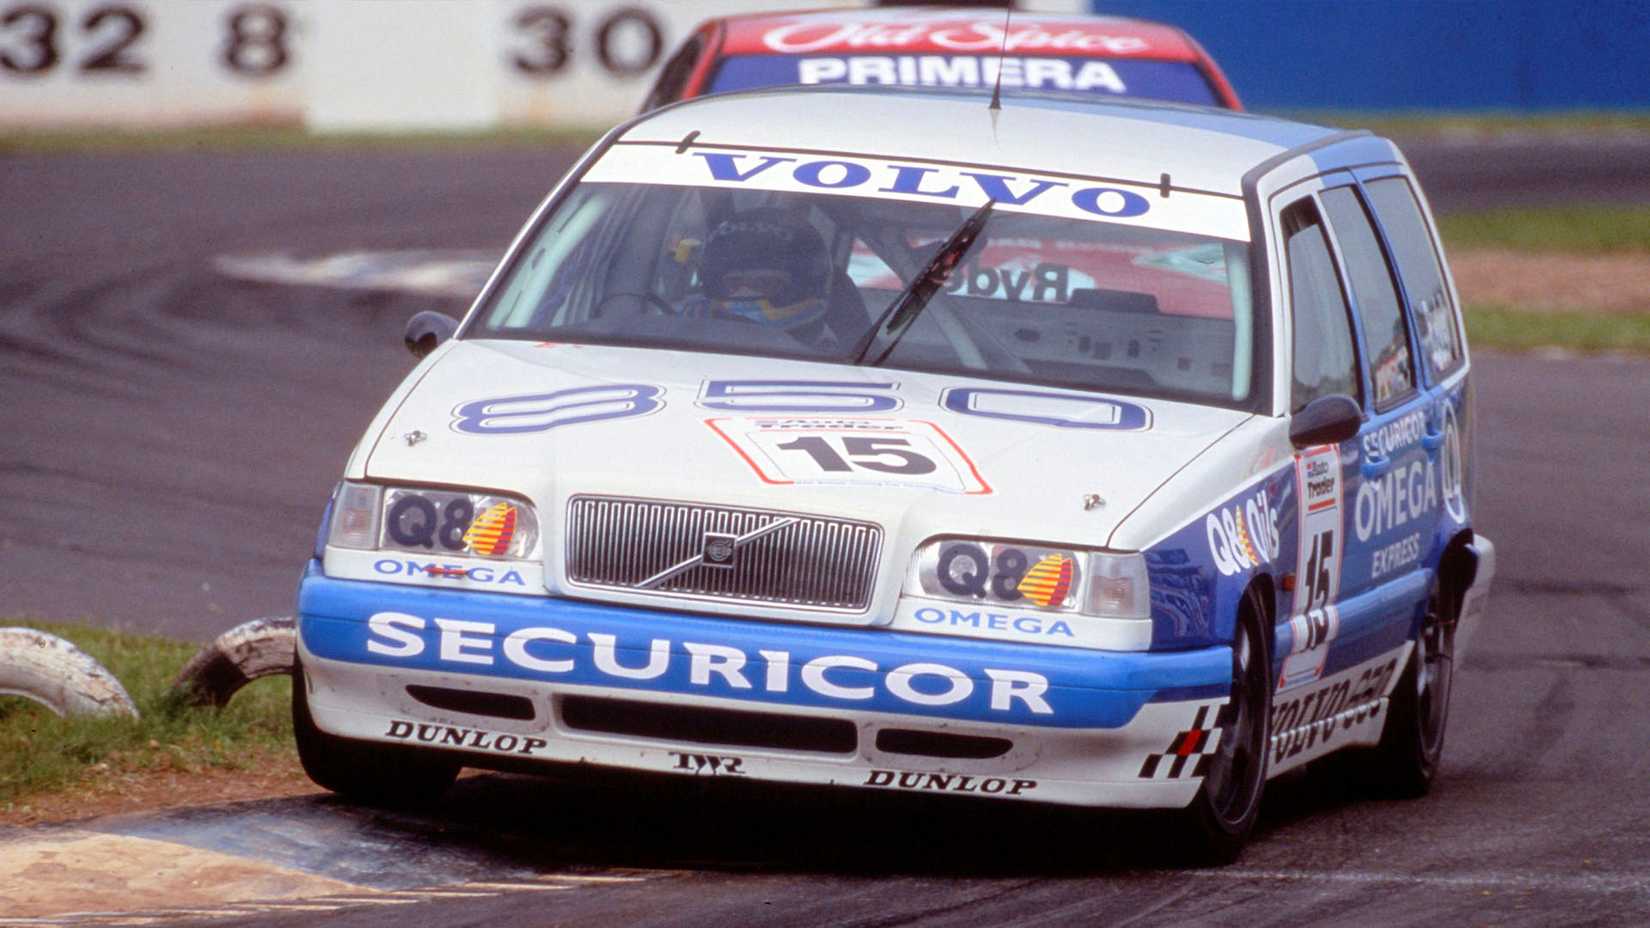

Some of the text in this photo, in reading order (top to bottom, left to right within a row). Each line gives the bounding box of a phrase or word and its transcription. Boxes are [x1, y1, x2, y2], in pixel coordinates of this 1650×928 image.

[0, 5, 665, 77] 32 8 30
[763, 20, 1150, 53] Old Spice
[799, 56, 1127, 93] PRIMERA
[692, 152, 1151, 218] VOLVO
[451, 378, 1154, 433] 850
[776, 436, 938, 476] 15
[1308, 477, 1336, 499] Trader
[1355, 460, 1437, 542] OMEGA
[388, 494, 475, 550] Q8
[1206, 507, 1251, 576] Q8
[373, 559, 526, 586] OMEGA
[937, 543, 1028, 601] Q8
[1371, 532, 1420, 578] EXPRESS
[1303, 528, 1333, 650] 15
[914, 607, 1074, 637] OMEGA
[366, 610, 1055, 715] SECURICOR
[385, 720, 548, 757] DUNLOP
[668, 750, 746, 778] TWR
[864, 769, 1038, 798] DUNLOP
